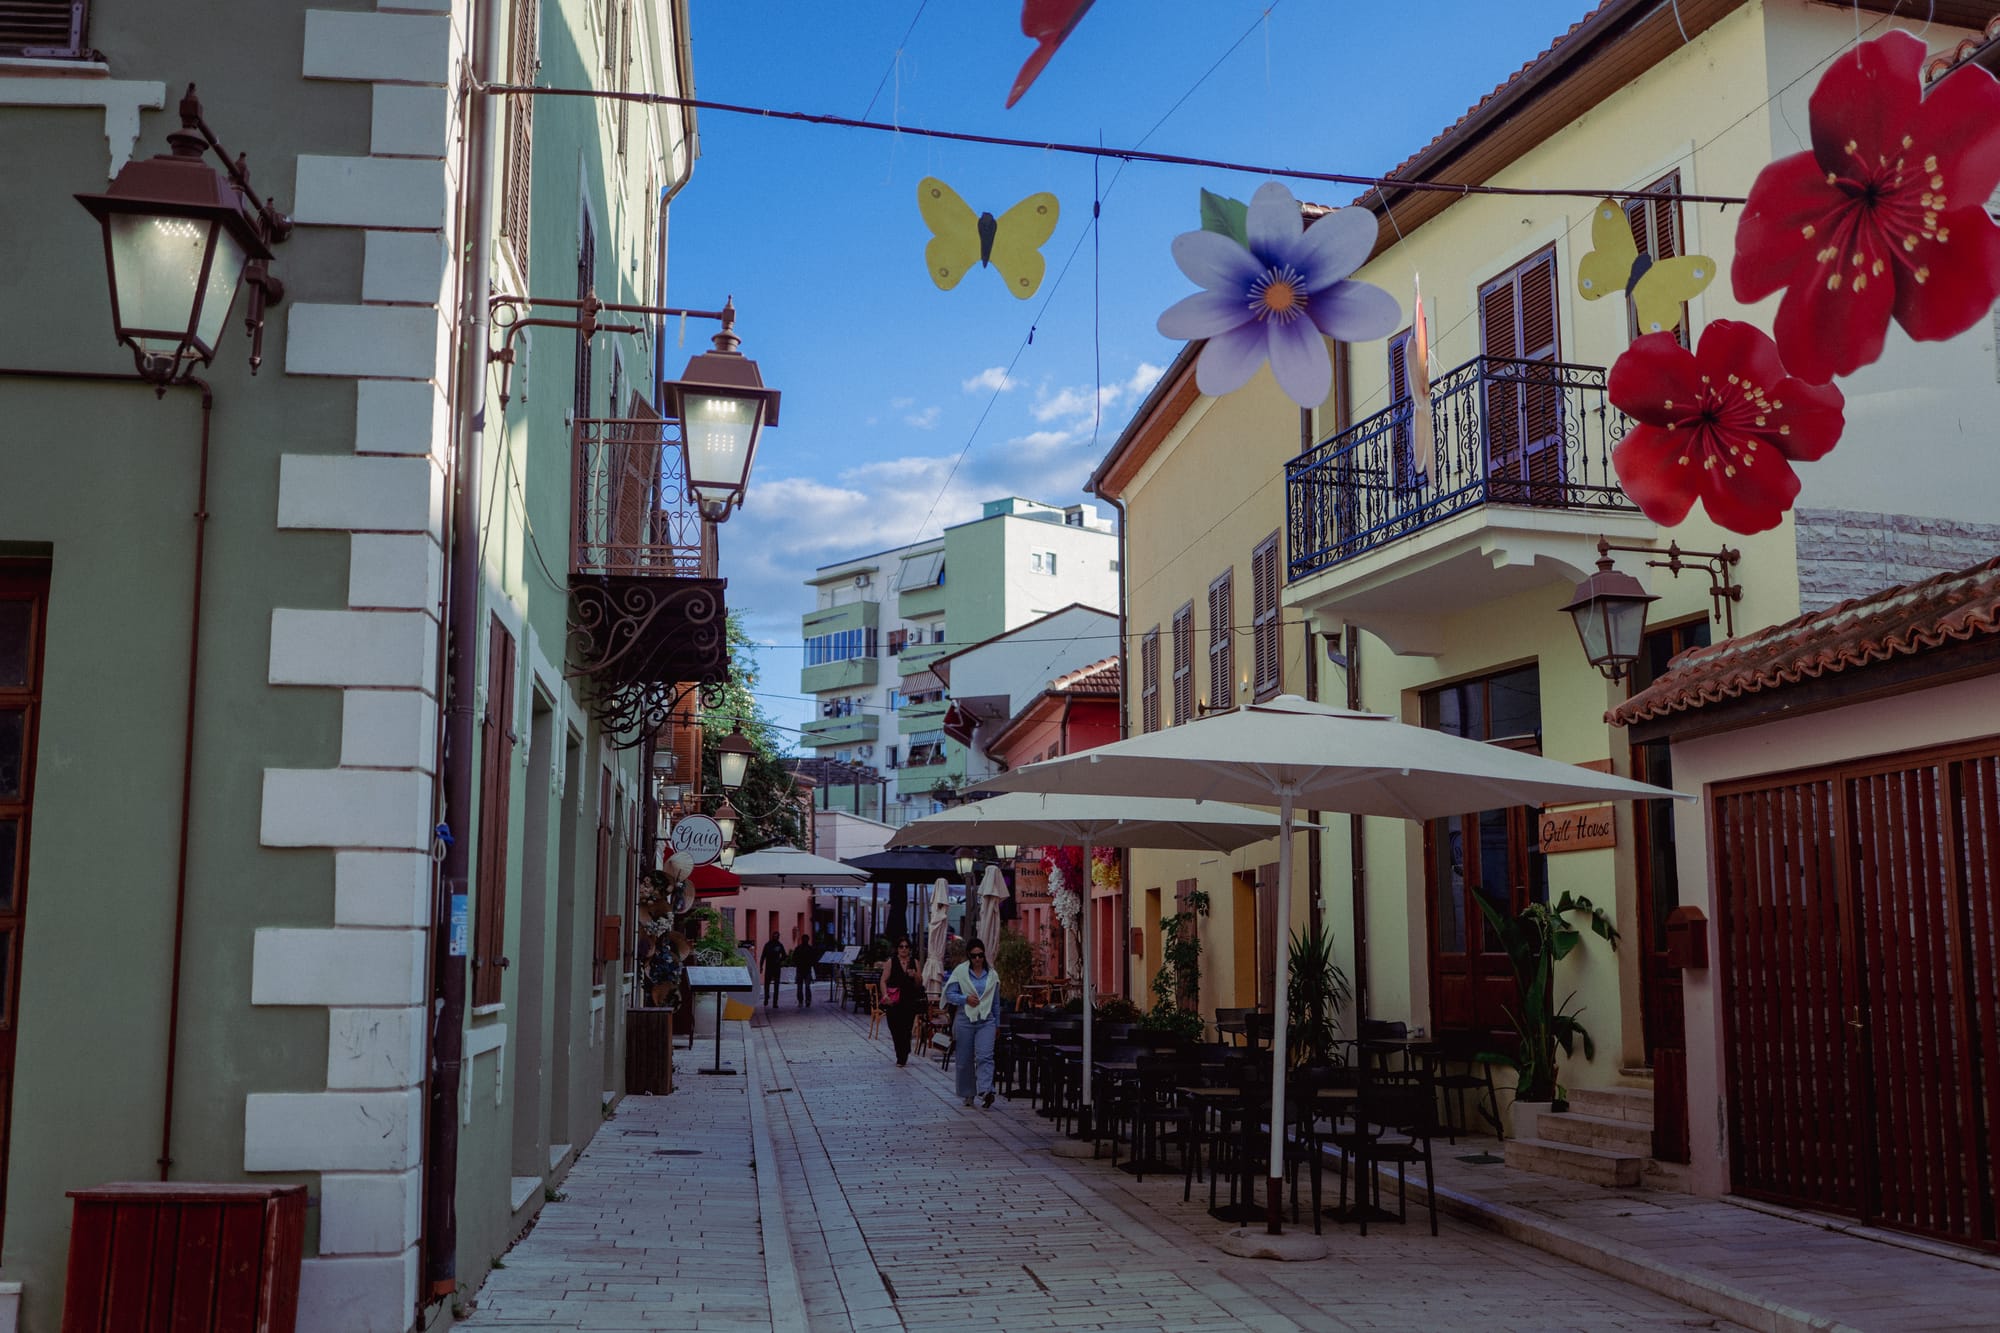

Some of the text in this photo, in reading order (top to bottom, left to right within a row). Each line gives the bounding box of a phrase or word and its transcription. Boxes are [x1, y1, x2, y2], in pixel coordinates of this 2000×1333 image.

[676, 825, 719, 851] Gaia
[1542, 815, 1609, 852] Grill House
